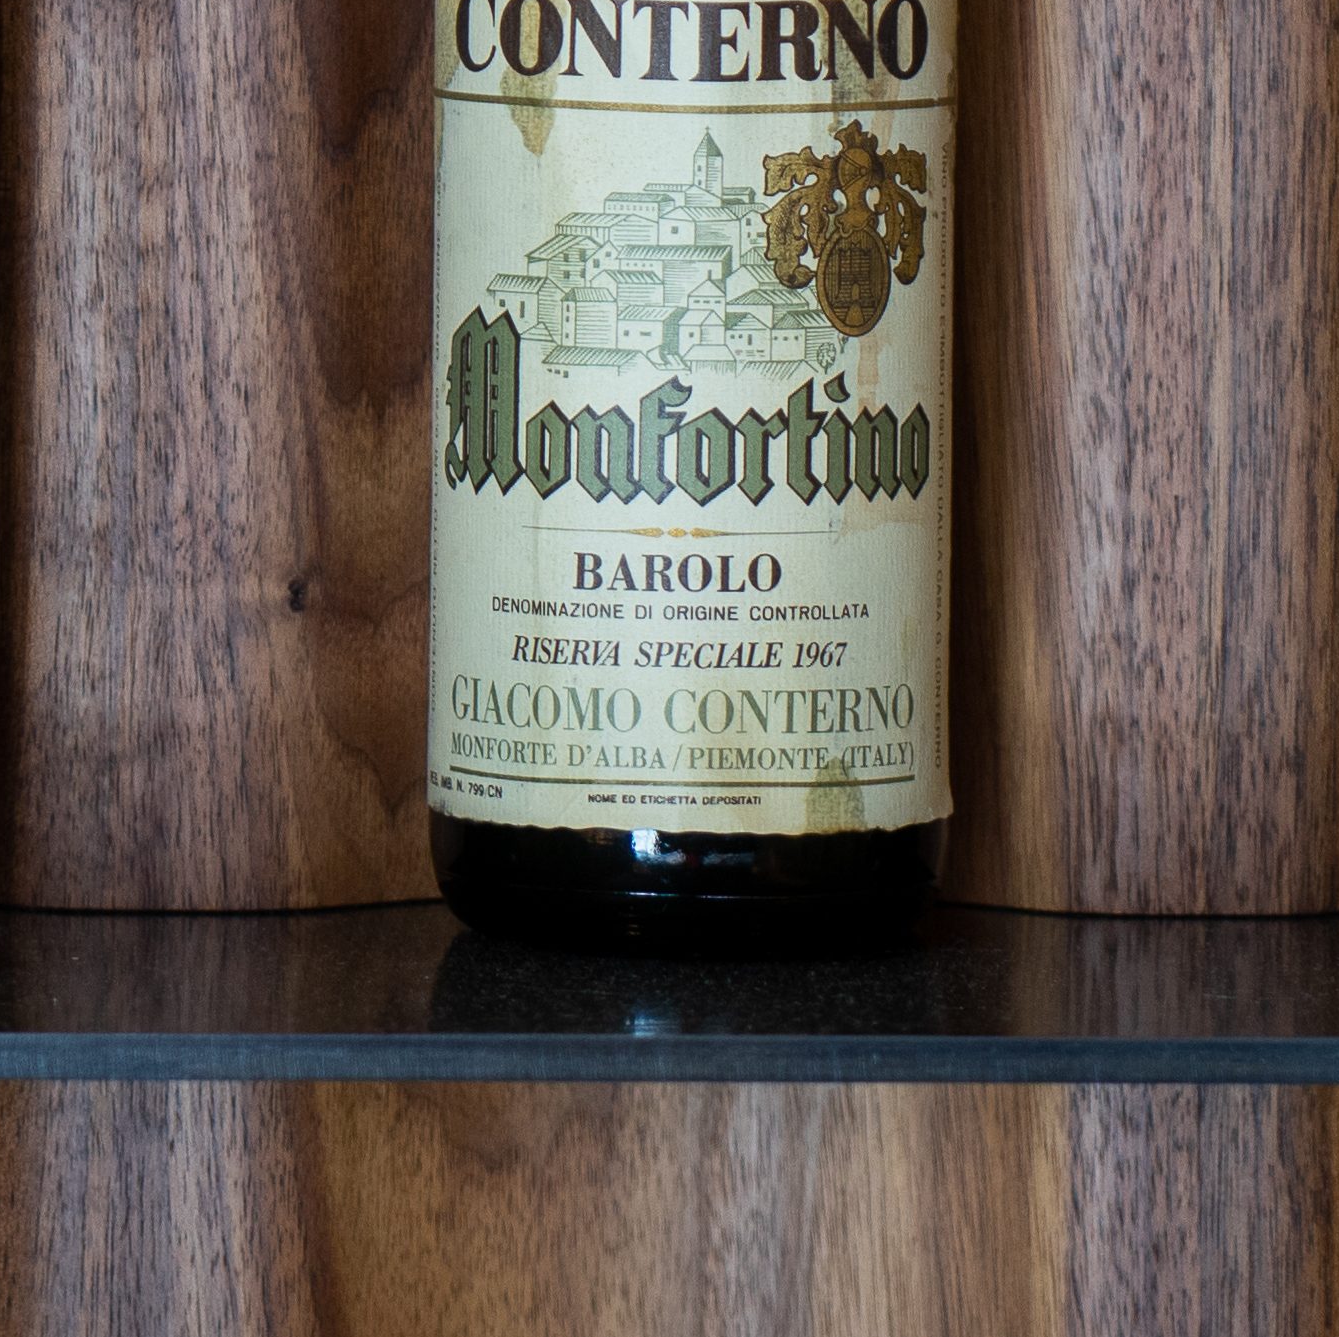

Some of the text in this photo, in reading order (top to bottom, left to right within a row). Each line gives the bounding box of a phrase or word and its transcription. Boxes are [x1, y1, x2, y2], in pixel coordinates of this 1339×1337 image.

[444, 305, 930, 507] Monfortino
[573, 551, 782, 593] BAROLO
[492, 596, 870, 621] DENOMINAZIONE DI ORIGINE CONTROLLATA
[511, 635, 848, 669] RISERVA SPECIALE 1967
[451, 674, 914, 735] GIACOMO CONTERNO
[451, 732, 557, 765] MONFORTE
[841, 741, 915, 776] (ITALY)
[588, 794, 761, 805] NOME ED ETICHETTA DEPOSITATI
